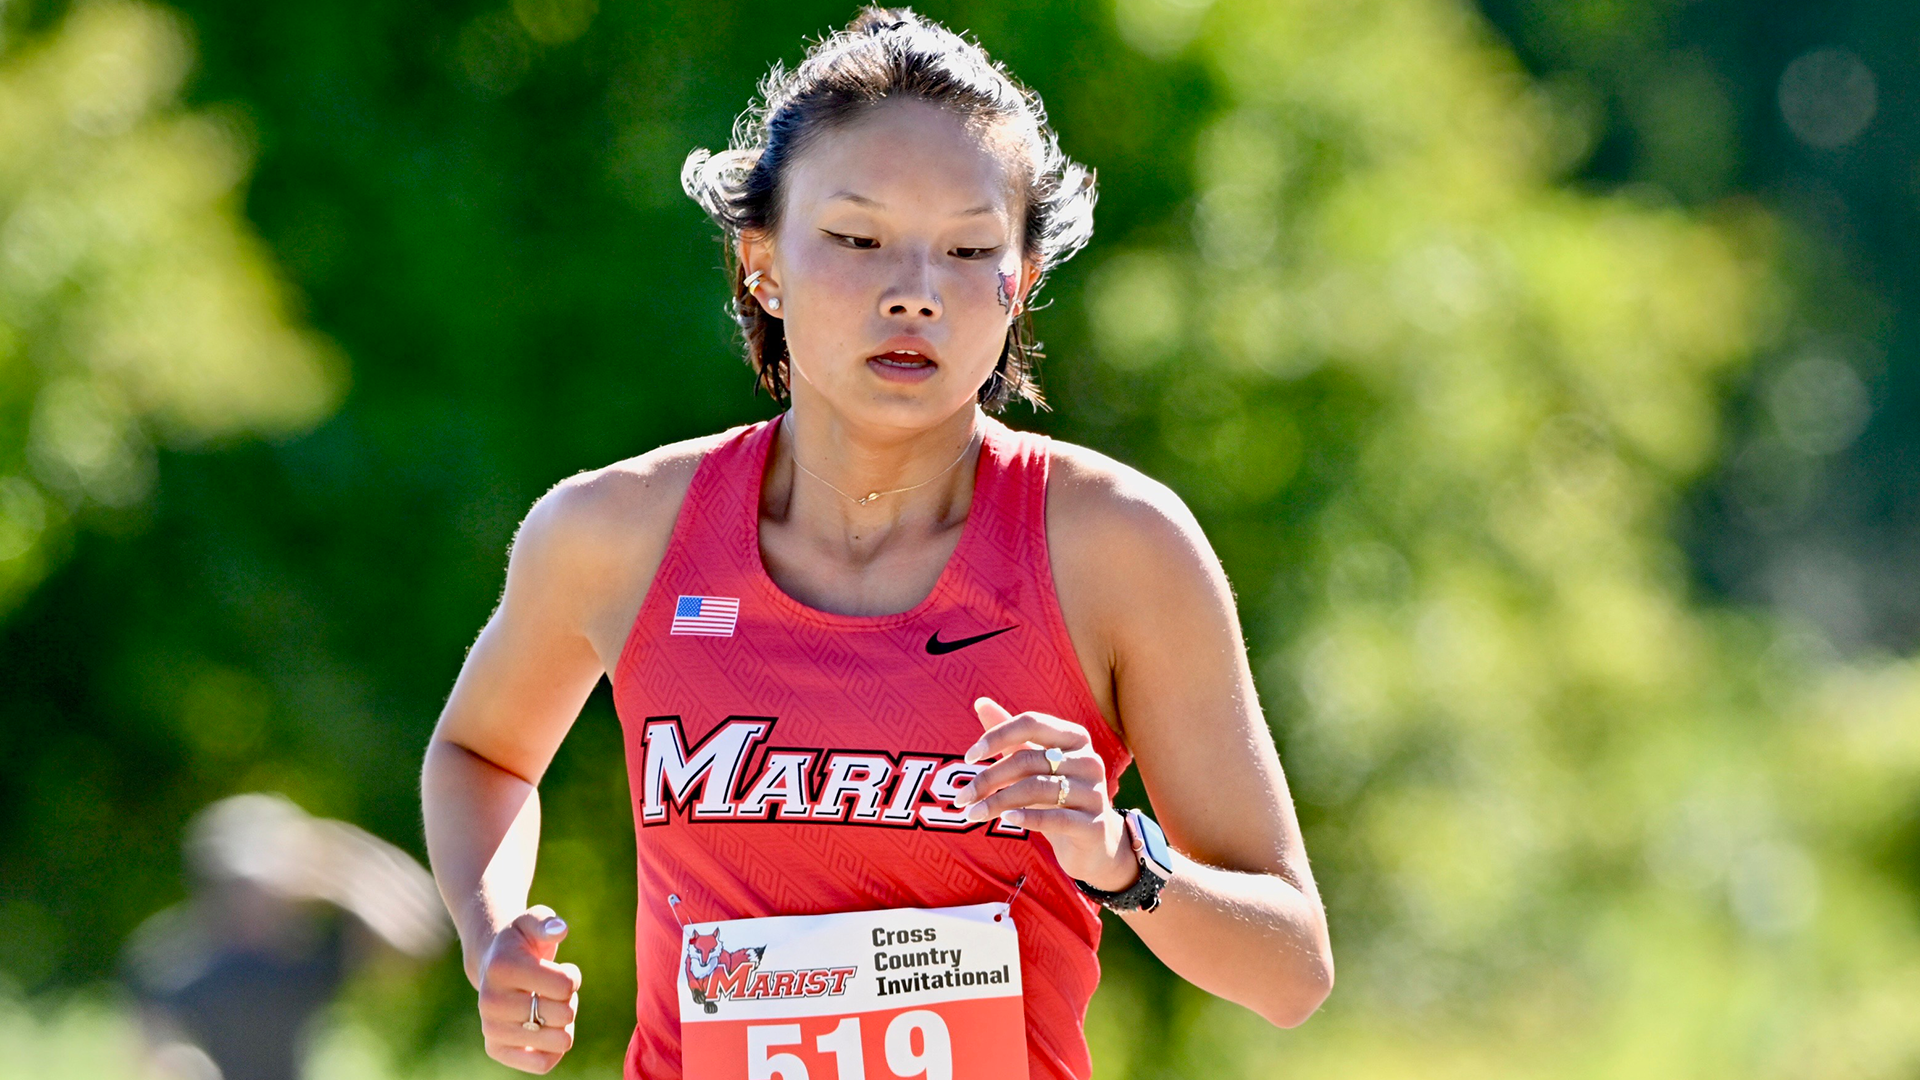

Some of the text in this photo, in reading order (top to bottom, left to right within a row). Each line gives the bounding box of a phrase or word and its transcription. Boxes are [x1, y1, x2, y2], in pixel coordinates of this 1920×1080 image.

[642, 716, 1028, 837] MARIS
[872, 927, 937, 947] Cross
[874, 949, 962, 972] Country
[704, 962, 858, 1001] MARIST
[876, 965, 1010, 997] Invitational
[747, 1009, 953, 1080] 519
